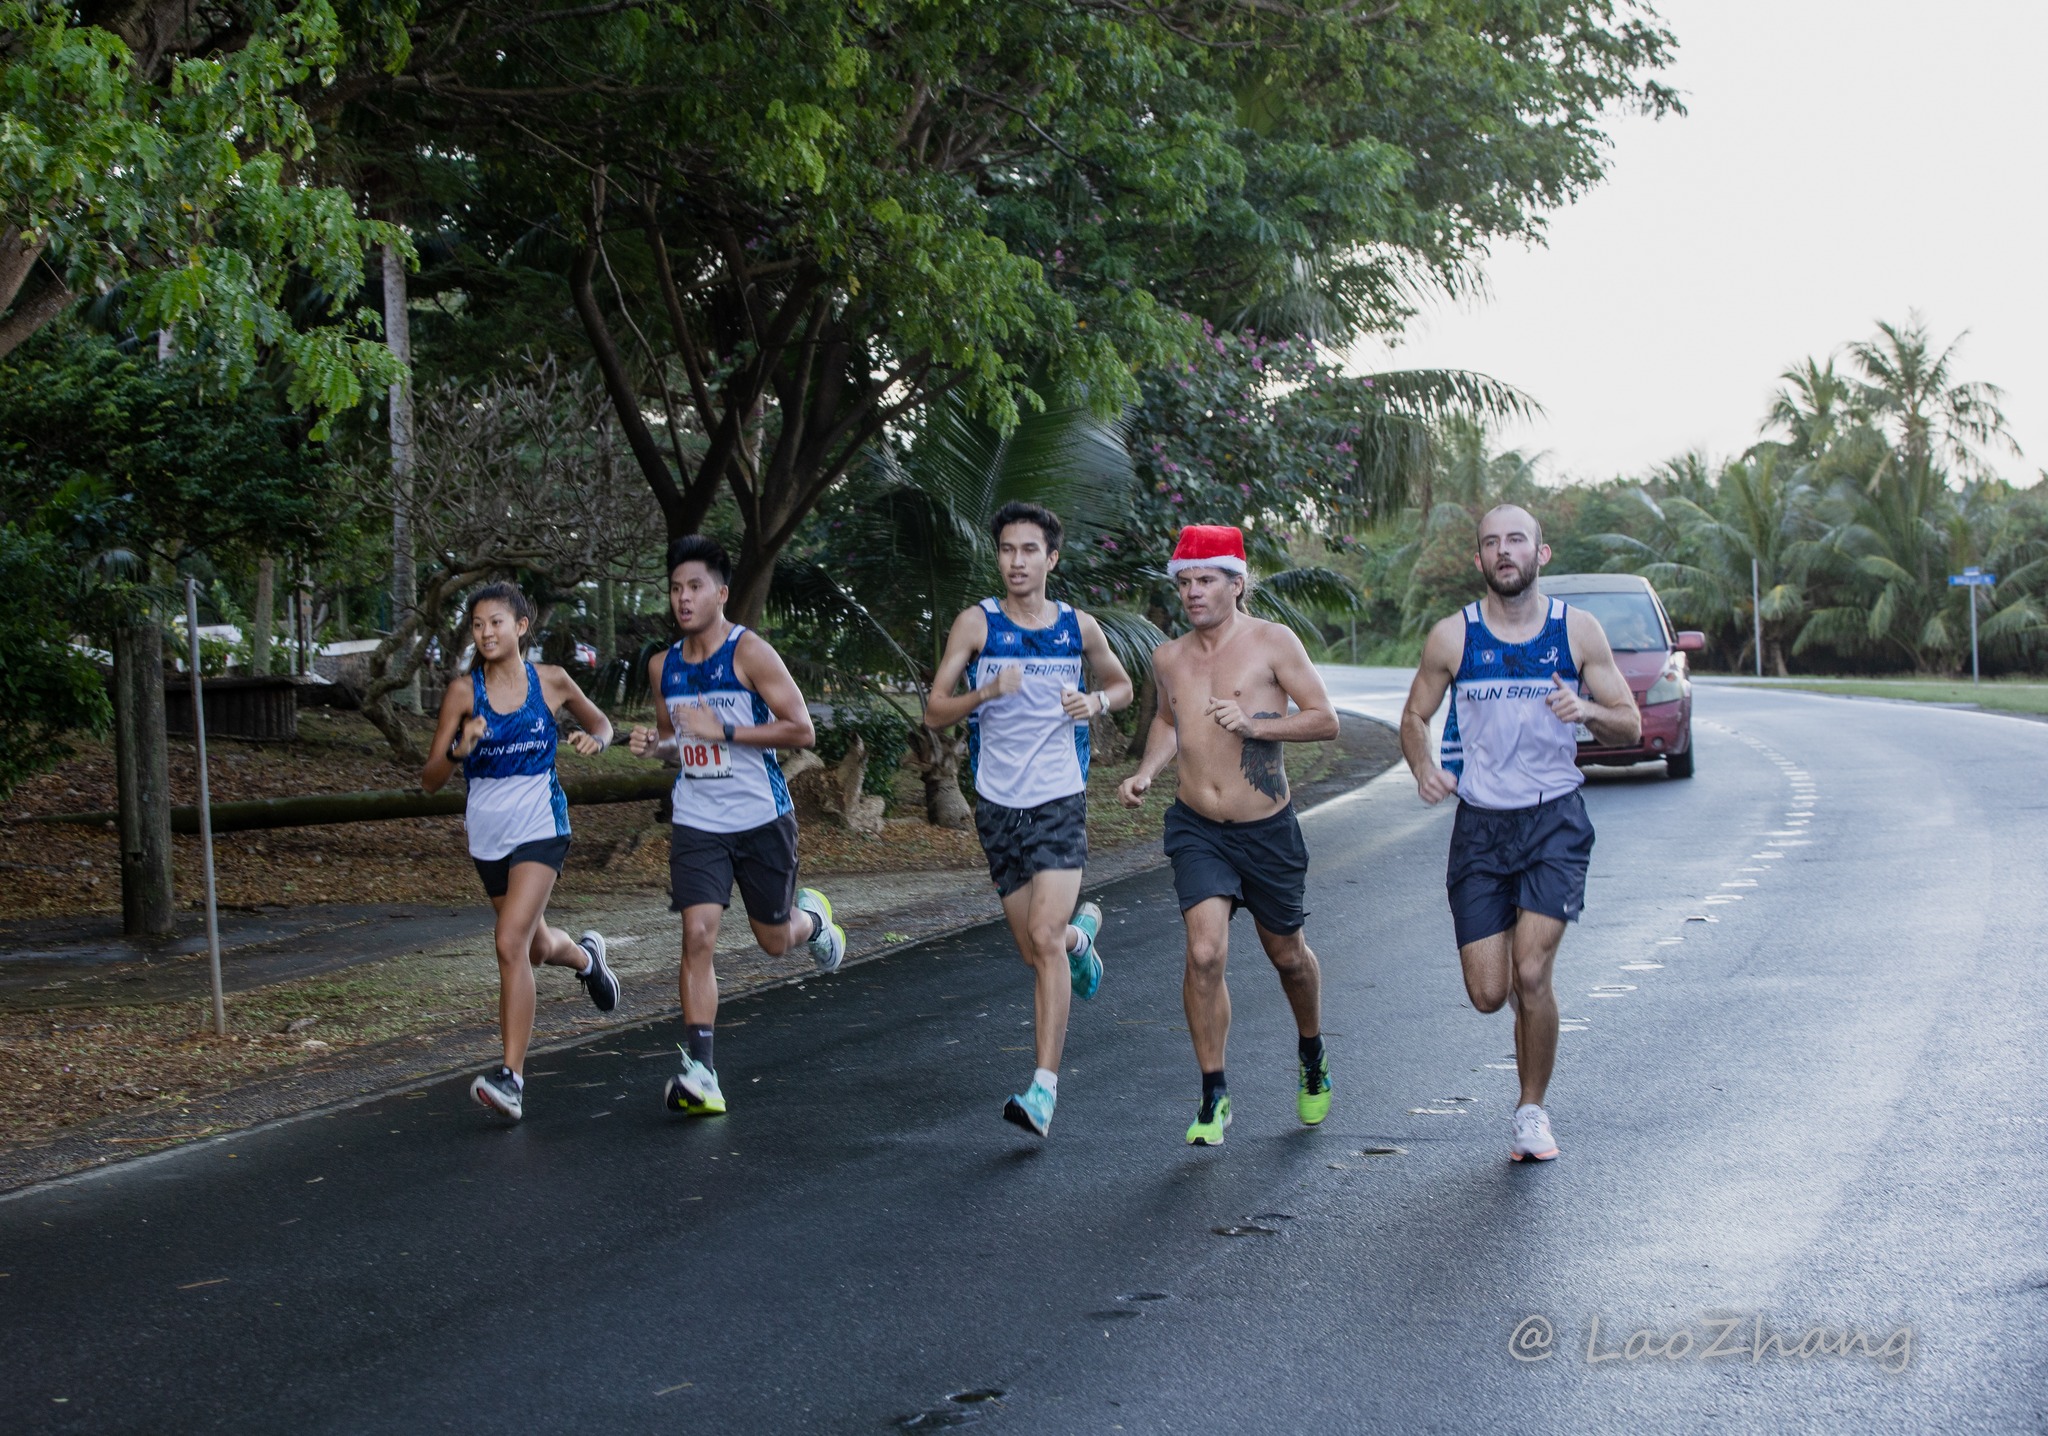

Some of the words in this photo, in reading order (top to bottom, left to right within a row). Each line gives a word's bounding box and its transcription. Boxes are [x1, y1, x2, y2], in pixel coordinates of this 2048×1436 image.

[1023, 663, 1078, 677] SAIPAN
[1466, 686, 1502, 701] RUN
[1506, 686, 1559, 700] SAIP
[480, 745, 505, 757] RUN
[506, 740, 549, 754] SAIPAN
[683, 743, 721, 767] 081
